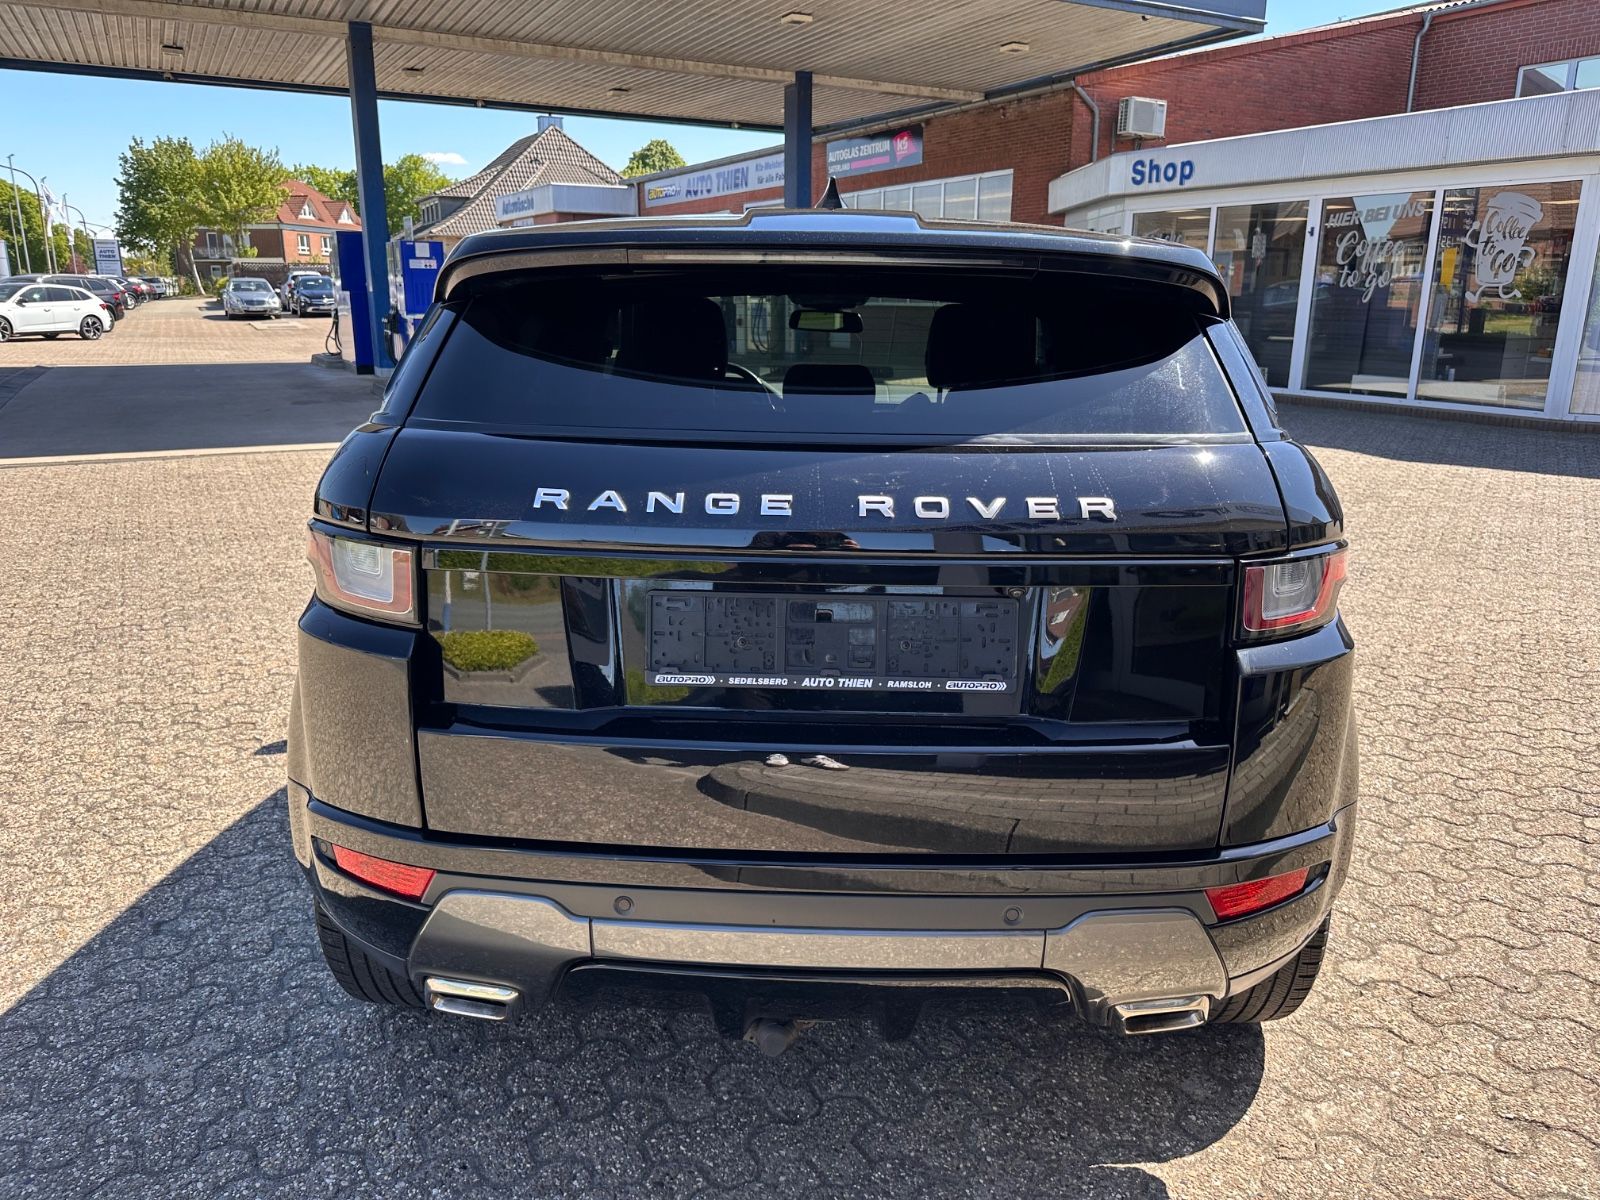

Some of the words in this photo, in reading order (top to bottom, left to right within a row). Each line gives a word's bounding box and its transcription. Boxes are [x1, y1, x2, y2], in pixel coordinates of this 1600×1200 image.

[828, 146, 860, 162] AUTOGLAS
[860, 139, 890, 157] ZENTRUM
[685, 174, 713, 198] AUTO
[715, 166, 750, 193] THIEN
[1131, 159, 1195, 186] Shop
[1327, 210, 1362, 228] HIER
[1363, 205, 1391, 223] BEI
[1392, 201, 1425, 219] UNS
[1486, 210, 1527, 240] Coffee
[1336, 230, 1405, 274] Coffee
[1339, 265, 1359, 288] to
[1362, 270, 1394, 303] go
[533, 487, 793, 516] RANGE
[857, 495, 1118, 521] ROVER
[728, 676, 788, 686] SEDELSBERG
[801, 677, 835, 688] AUTO
[837, 678, 873, 688] THIEN
[887, 680, 932, 689] RAMSLOH
